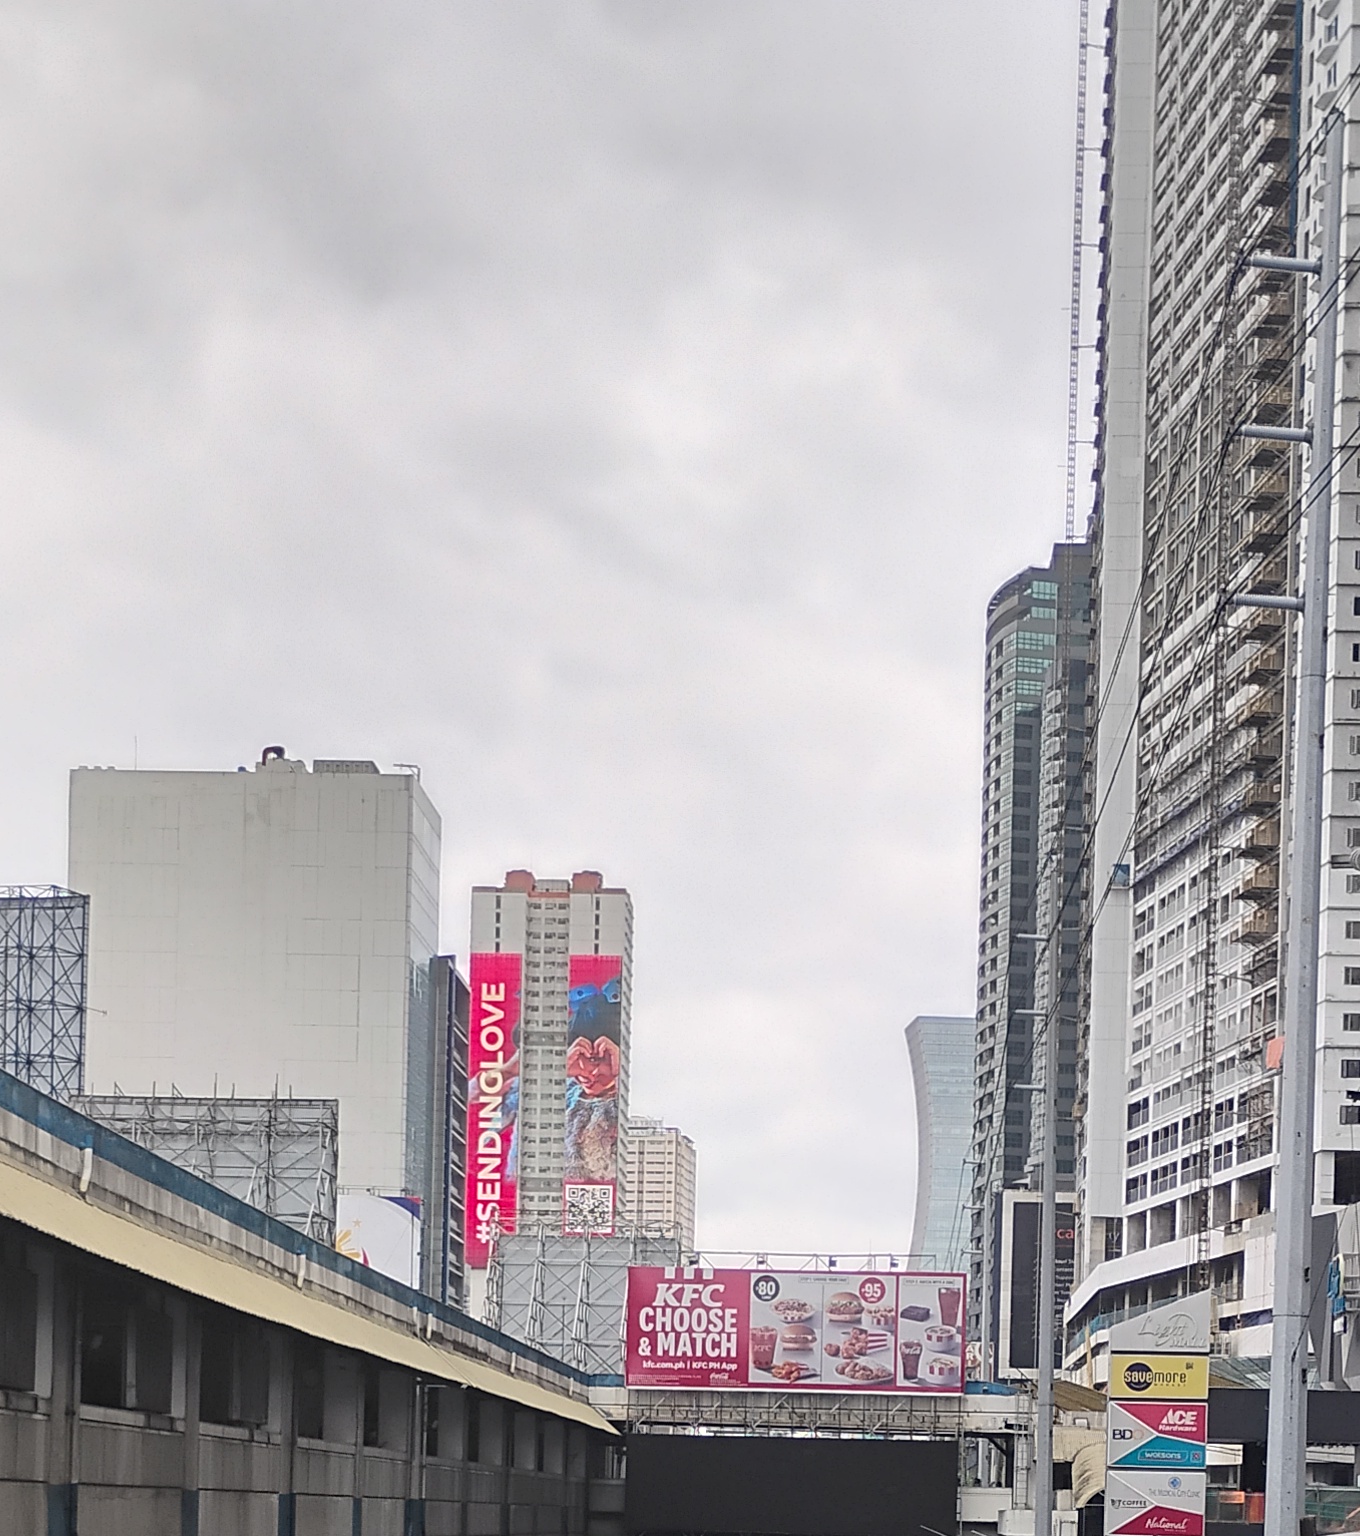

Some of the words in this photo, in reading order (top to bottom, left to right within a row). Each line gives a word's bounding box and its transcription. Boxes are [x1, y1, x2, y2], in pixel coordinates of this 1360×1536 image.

[476, 982, 506, 1244] #SENDINGLOVE
[652, 1283, 725, 1307] KFC
[639, 1306, 738, 1333] CHOOSE
[638, 1336, 652, 1356] &
[657, 1332, 737, 1358] MATCH
[721, 1361, 738, 1371] App
[1124, 1370, 1187, 1384] savemore
[1160, 1408, 1198, 1425] ACE
[1158, 1424, 1198, 1432] Hardware
[1145, 1450, 1182, 1459] watsons
[1145, 1517, 1188, 1530] National
